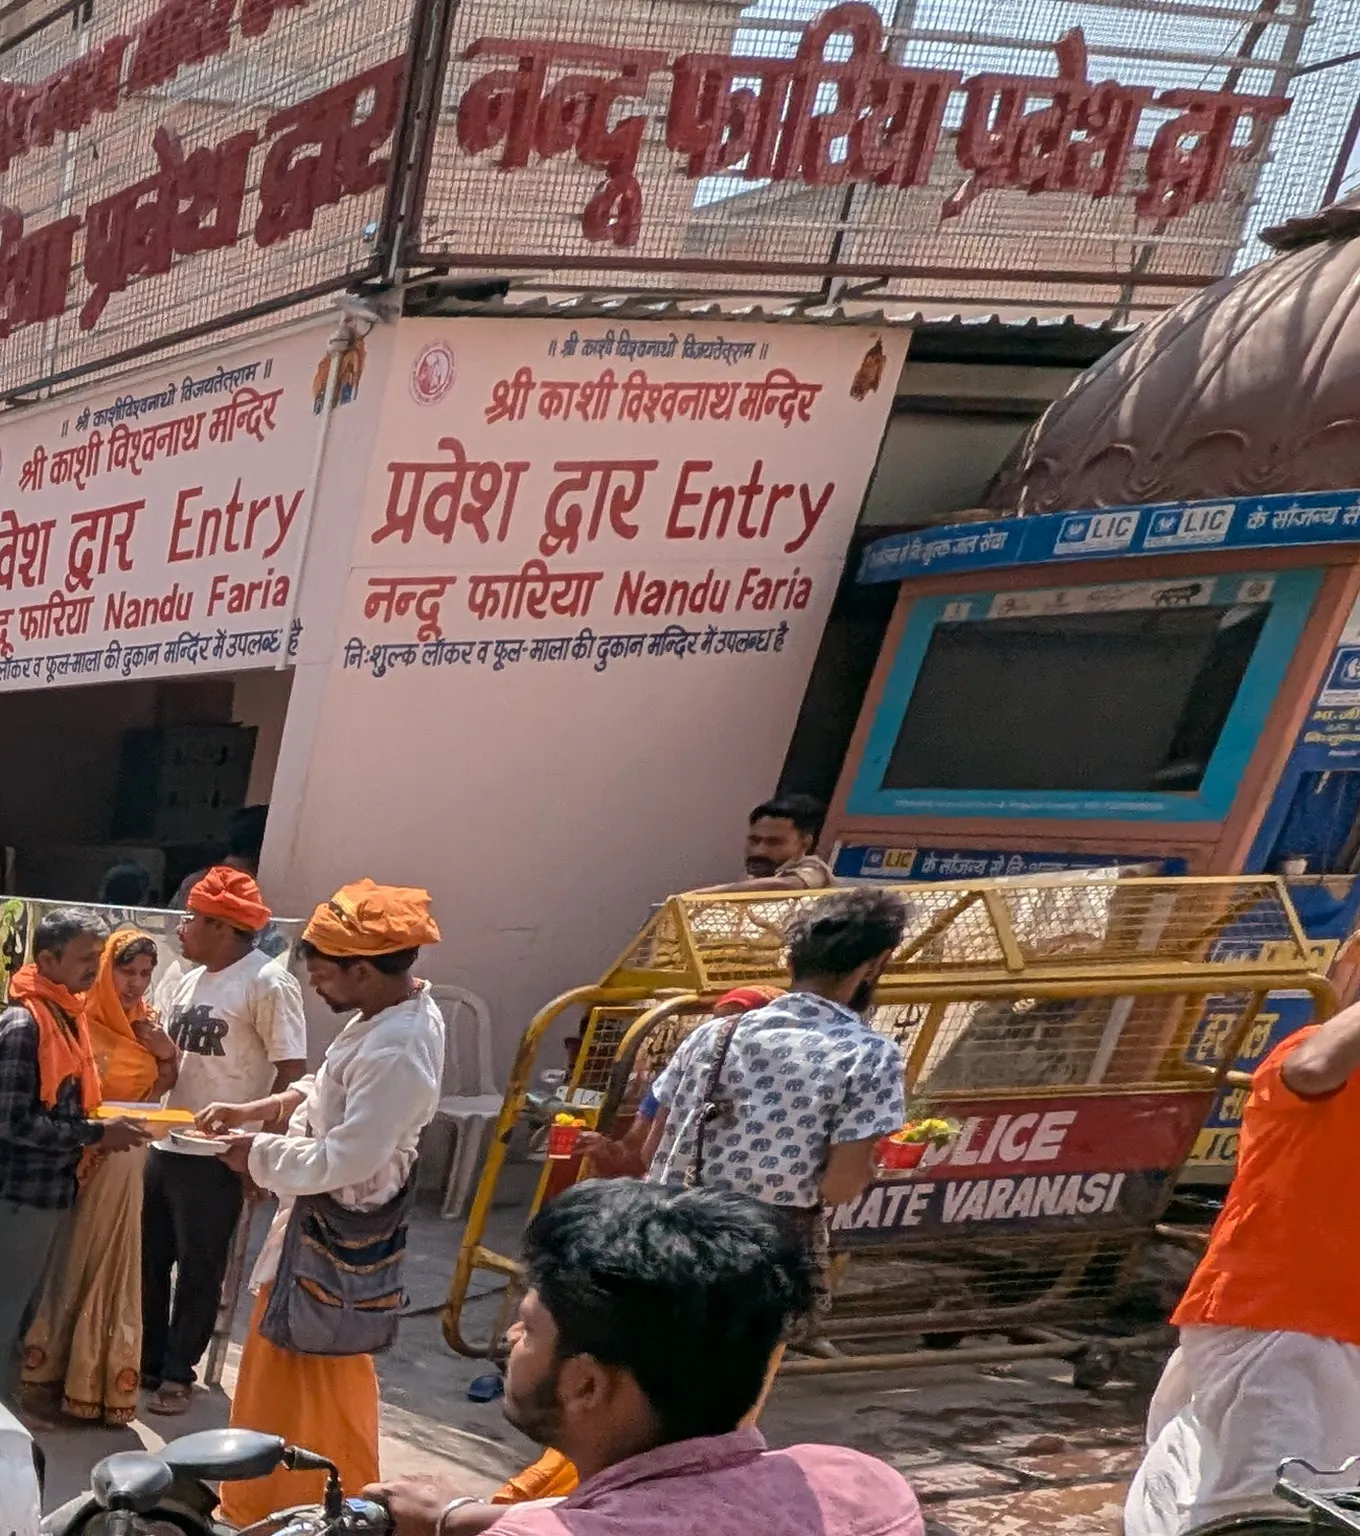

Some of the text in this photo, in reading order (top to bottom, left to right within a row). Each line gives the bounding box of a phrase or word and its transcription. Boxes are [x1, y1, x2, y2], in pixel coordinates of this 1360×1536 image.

[485, 366, 822, 429] श्री काशी विश्वनाथ मन्दिर
[18, 387, 285, 492] श्री काशी विश्वनाथ मन्दिर
[370, 437, 836, 557] प्रवेश द्वार Entry
[1091, 516, 1134, 541] LIC
[1184, 510, 1227, 534] LIC
[65, 498, 146, 593] द्वार
[167, 477, 305, 563] Entry
[18, 589, 95, 641] फारिया
[104, 583, 193, 631] Nandu
[206, 567, 291, 617] Faria
[363, 559, 813, 645] नन्दू फारिया Nandu Faria
[570, 627, 596, 663] की
[594, 632, 646, 671] दुकान
[646, 624, 698, 659] मन्दिर
[886, 851, 913, 869] LIC
[941, 1172, 1127, 1225] VARANASI
